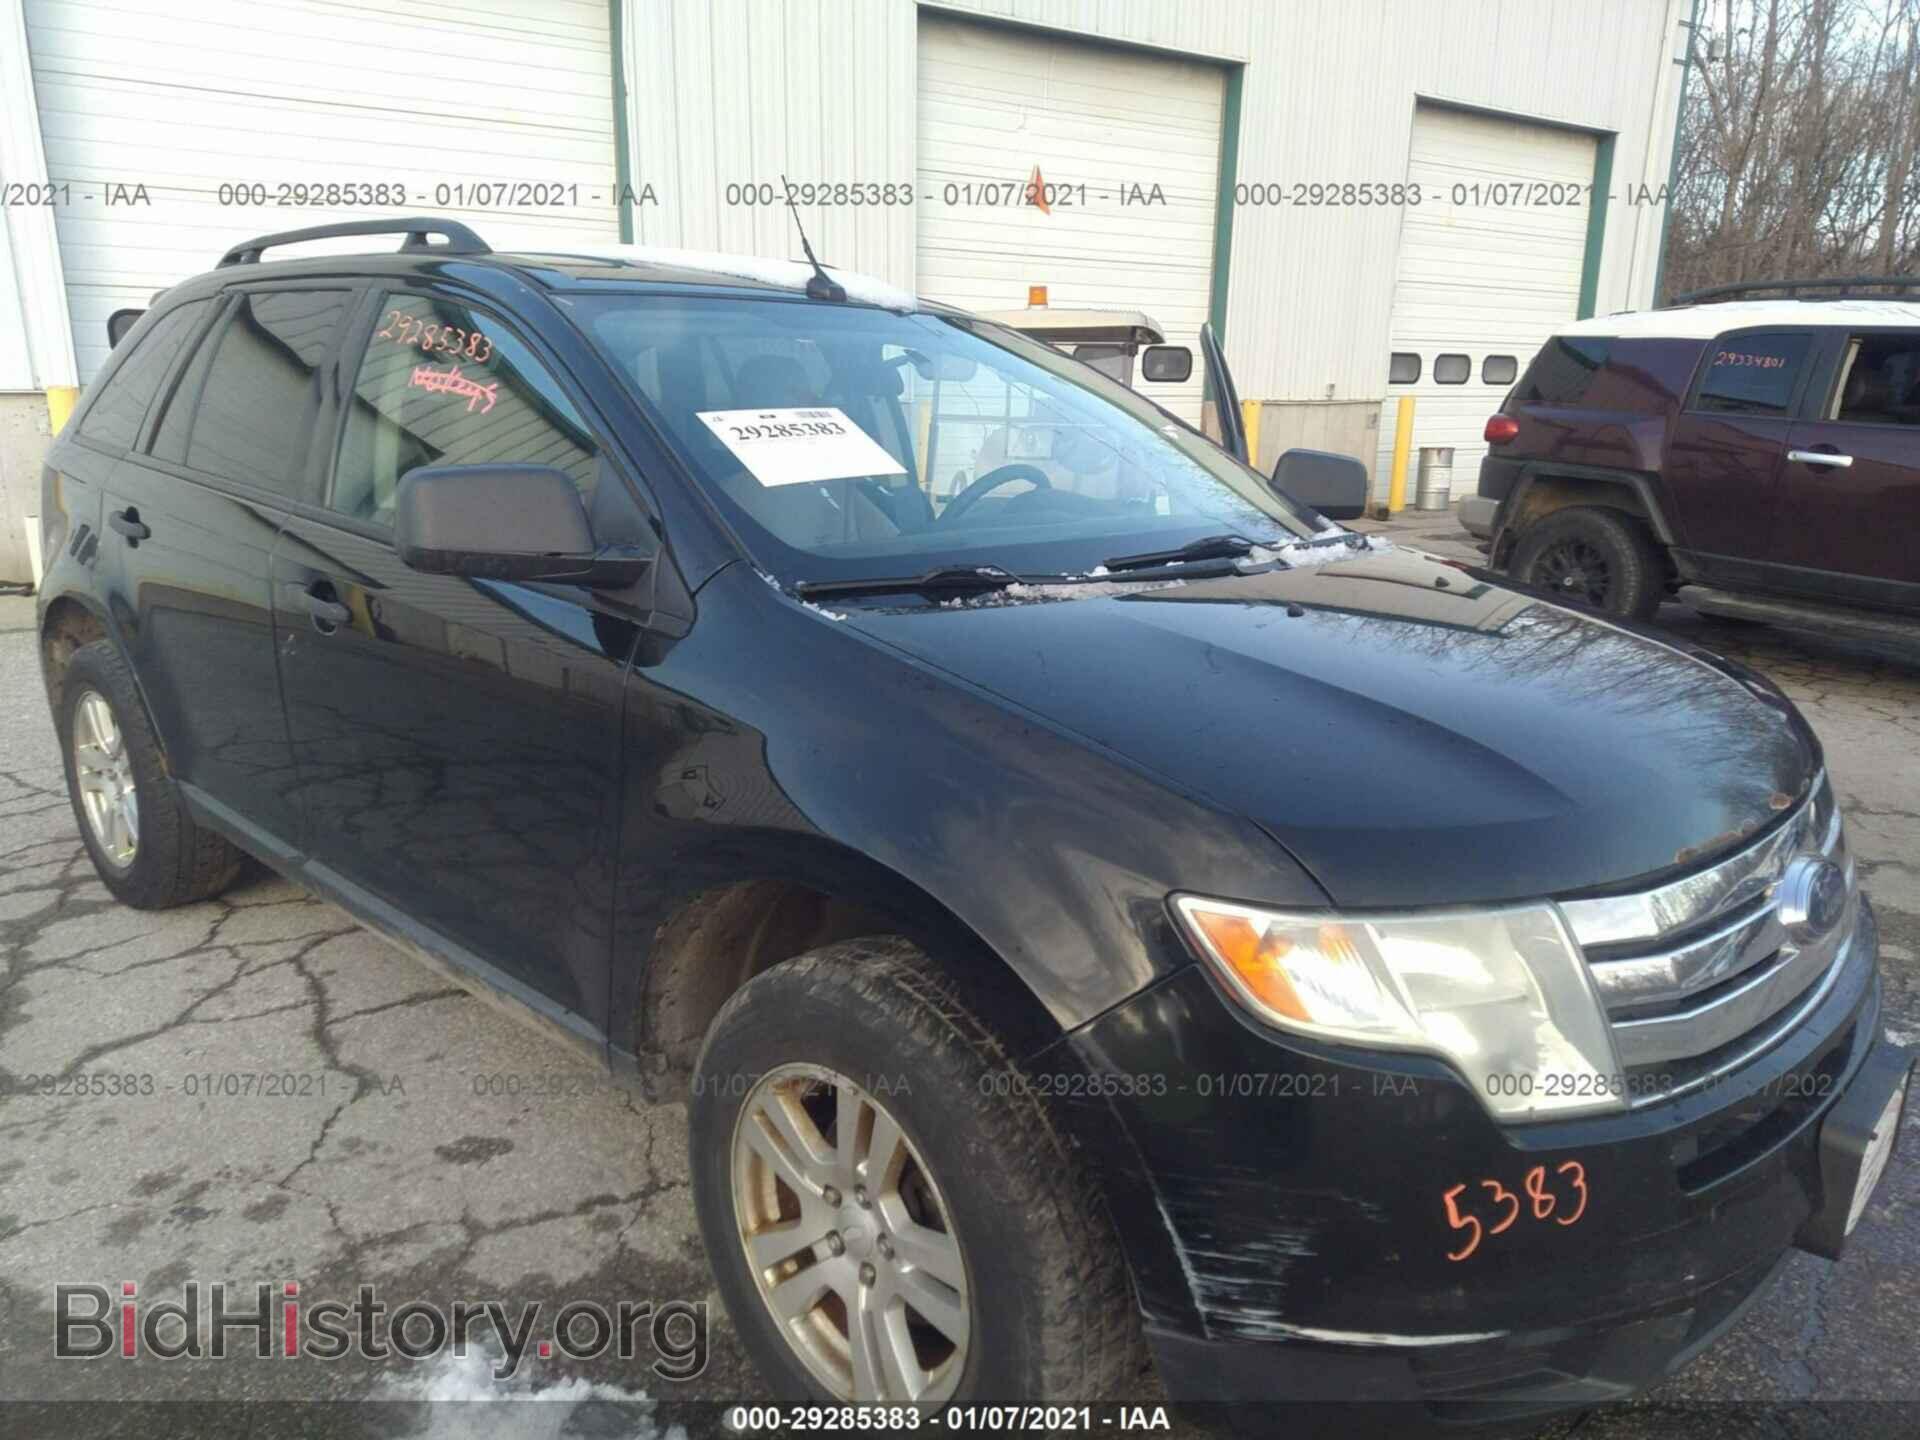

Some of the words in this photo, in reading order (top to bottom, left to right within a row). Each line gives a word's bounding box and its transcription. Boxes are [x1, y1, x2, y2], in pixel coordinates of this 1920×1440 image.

[378, 310, 493, 363] 29285383
[730, 422, 847, 441] 29285383
[1444, 1160, 1591, 1262] 5383
